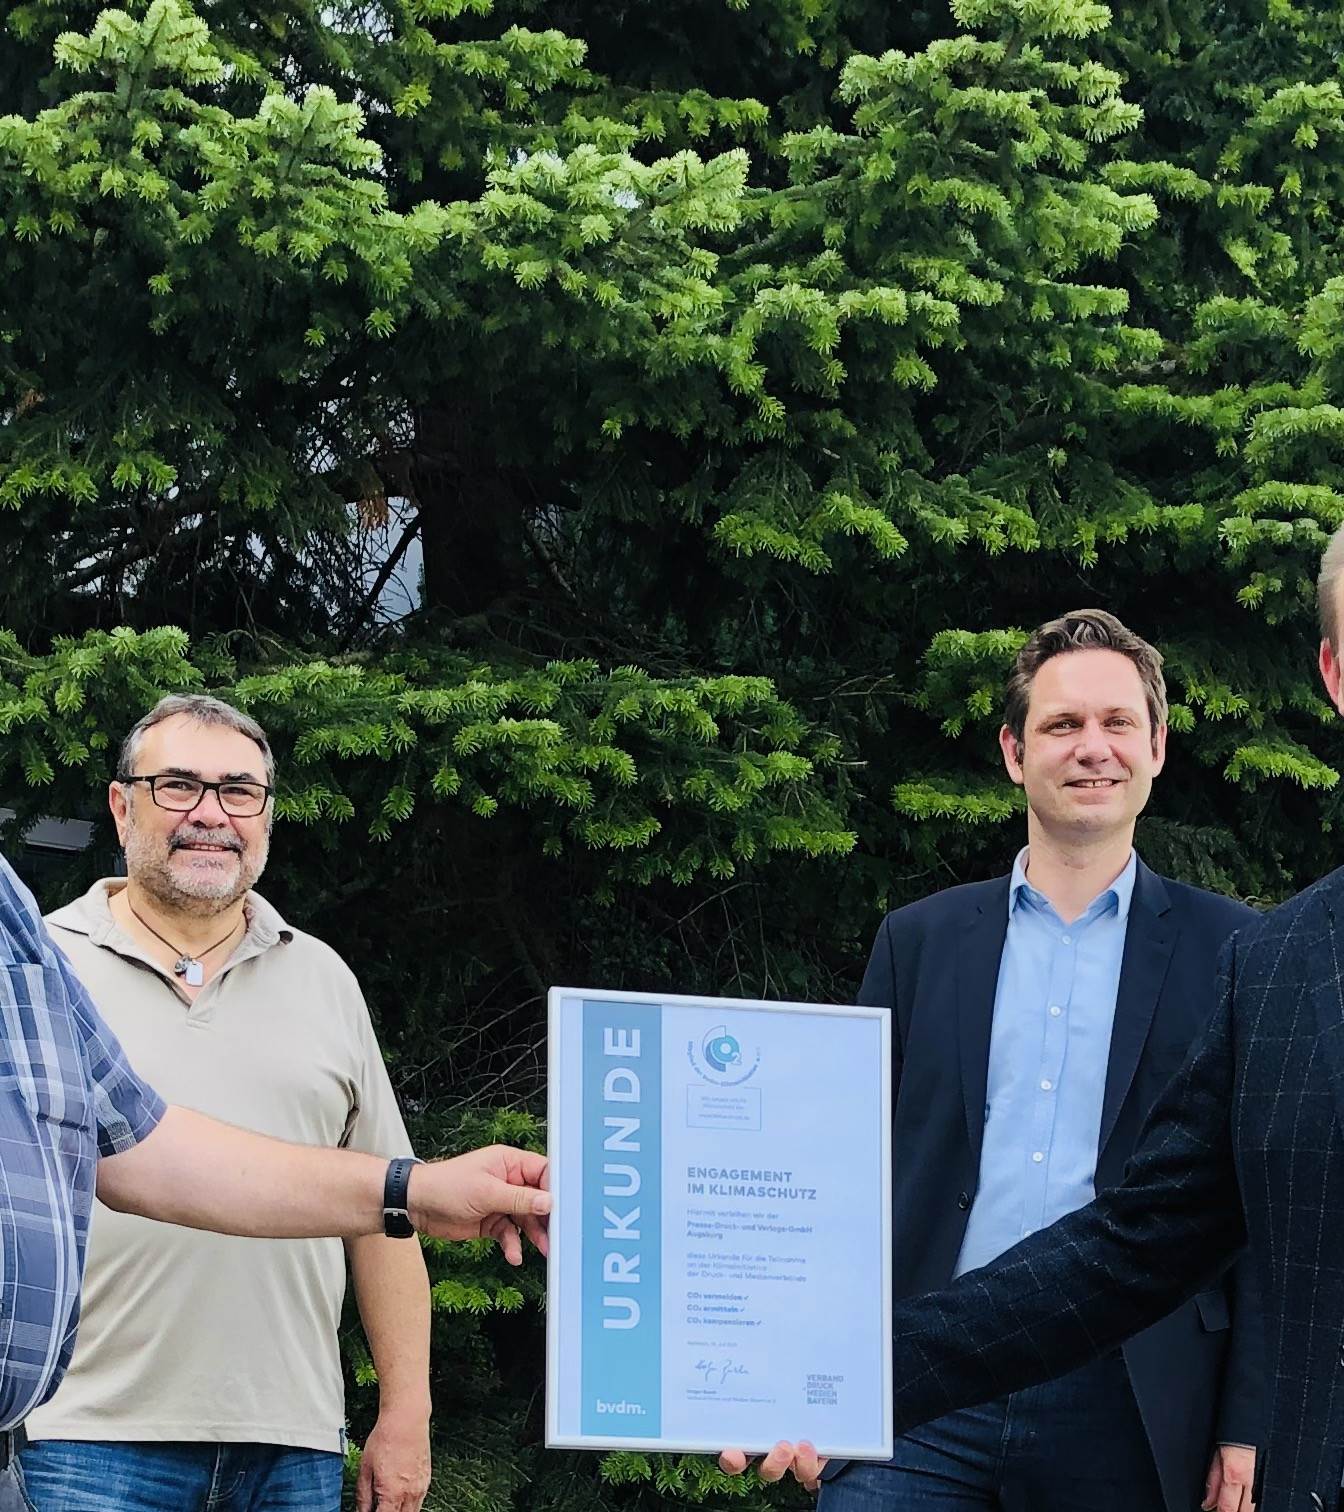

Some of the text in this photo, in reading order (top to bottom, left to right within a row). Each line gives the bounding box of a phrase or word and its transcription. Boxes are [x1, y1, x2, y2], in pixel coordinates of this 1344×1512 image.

[603, 1027, 641, 1329] URKUNDE
[687, 1166, 793, 1183] ENGAGEMENT
[687, 1183, 817, 1200] IM KLIMASCHUTZ
[741, 1223, 756, 1231] und
[687, 1230, 723, 1240] Augsburg
[806, 1374, 844, 1382] VERBAND
[806, 1381, 834, 1390] DRUCK
[806, 1389, 838, 1398] MEDIEN
[806, 1397, 838, 1405] BAYERN
[596, 1398, 646, 1415] bvdm.
